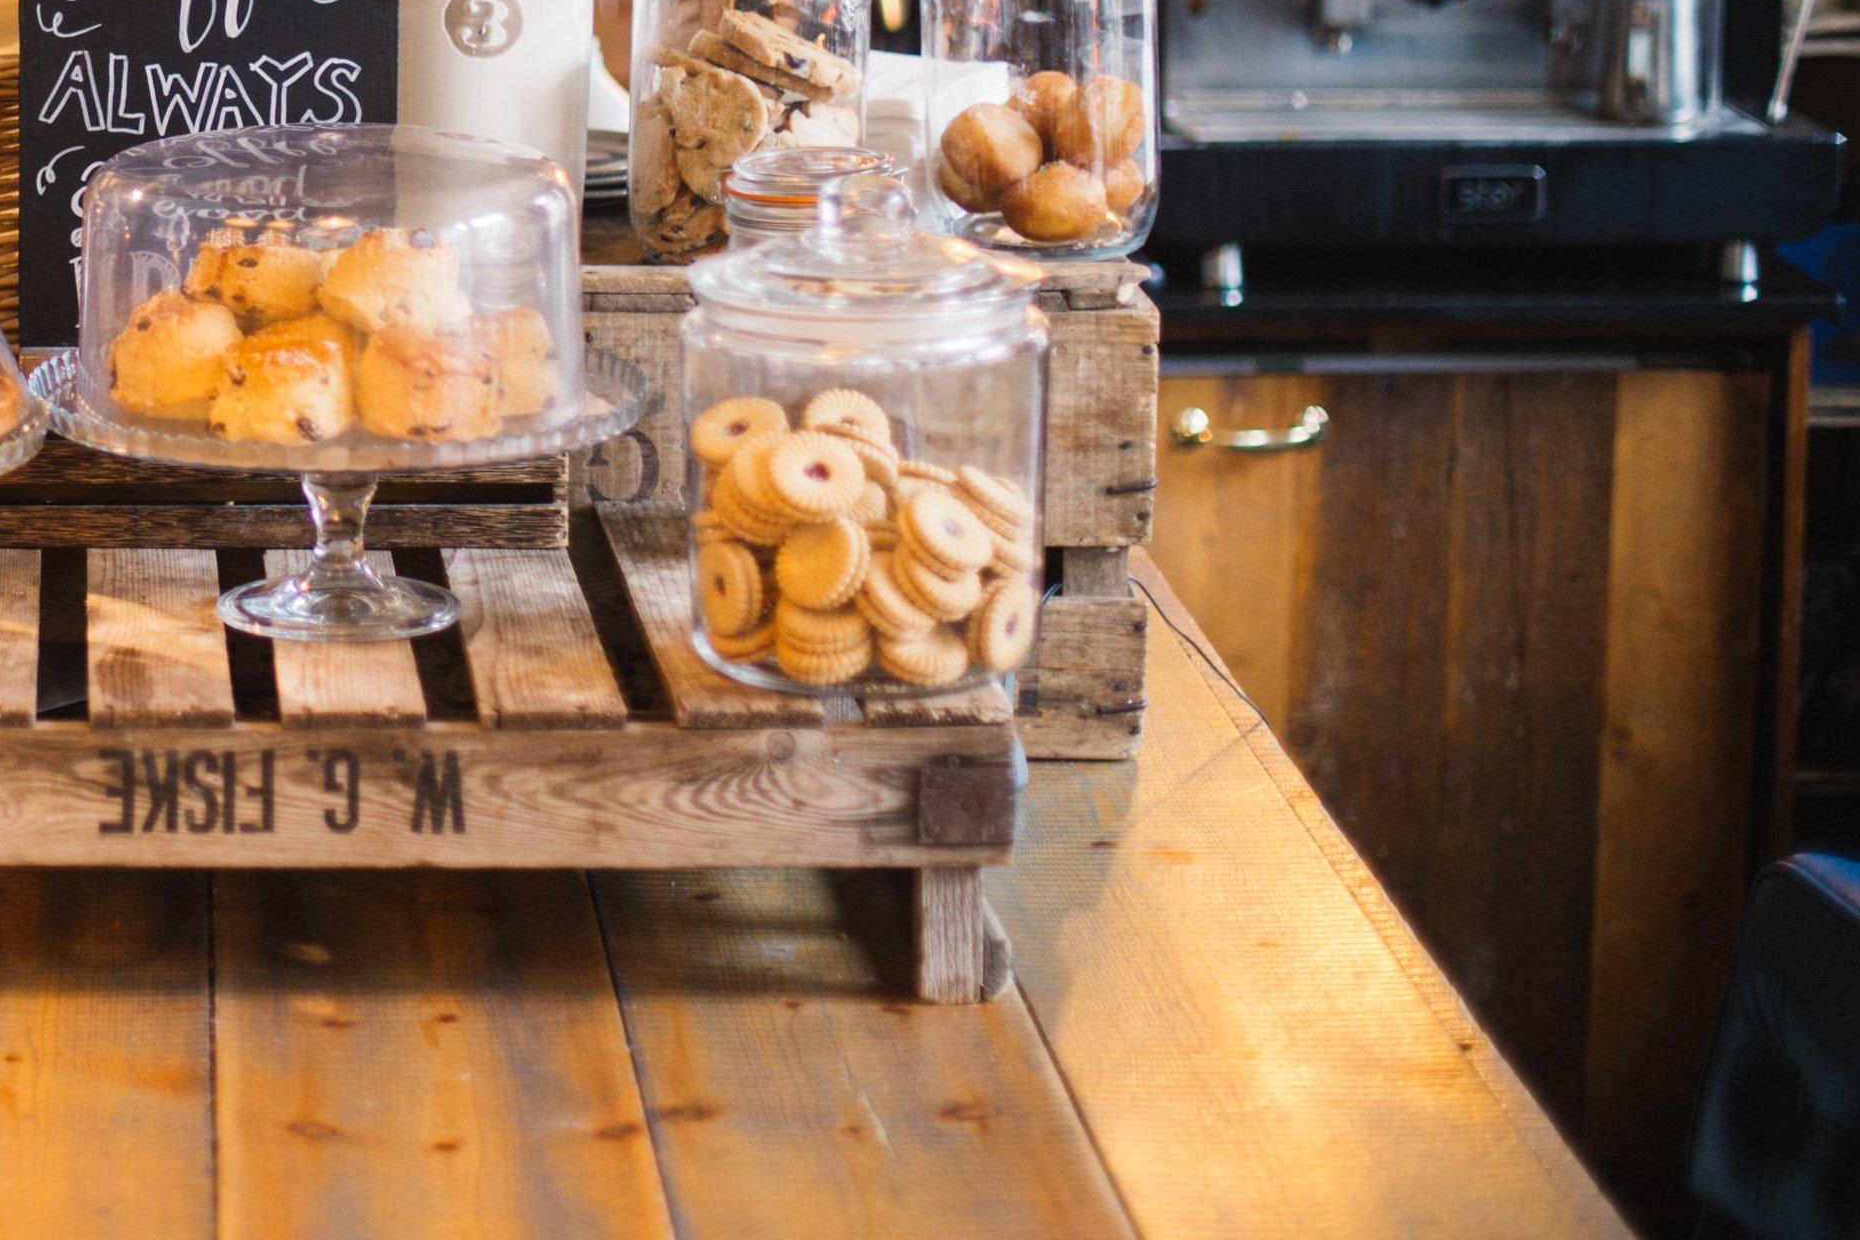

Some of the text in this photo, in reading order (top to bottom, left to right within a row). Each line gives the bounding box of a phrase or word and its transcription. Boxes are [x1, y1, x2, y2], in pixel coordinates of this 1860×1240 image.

[39, 49, 364, 136] ALWAYS
[98, 749, 466, 834] W. G. FISKE
